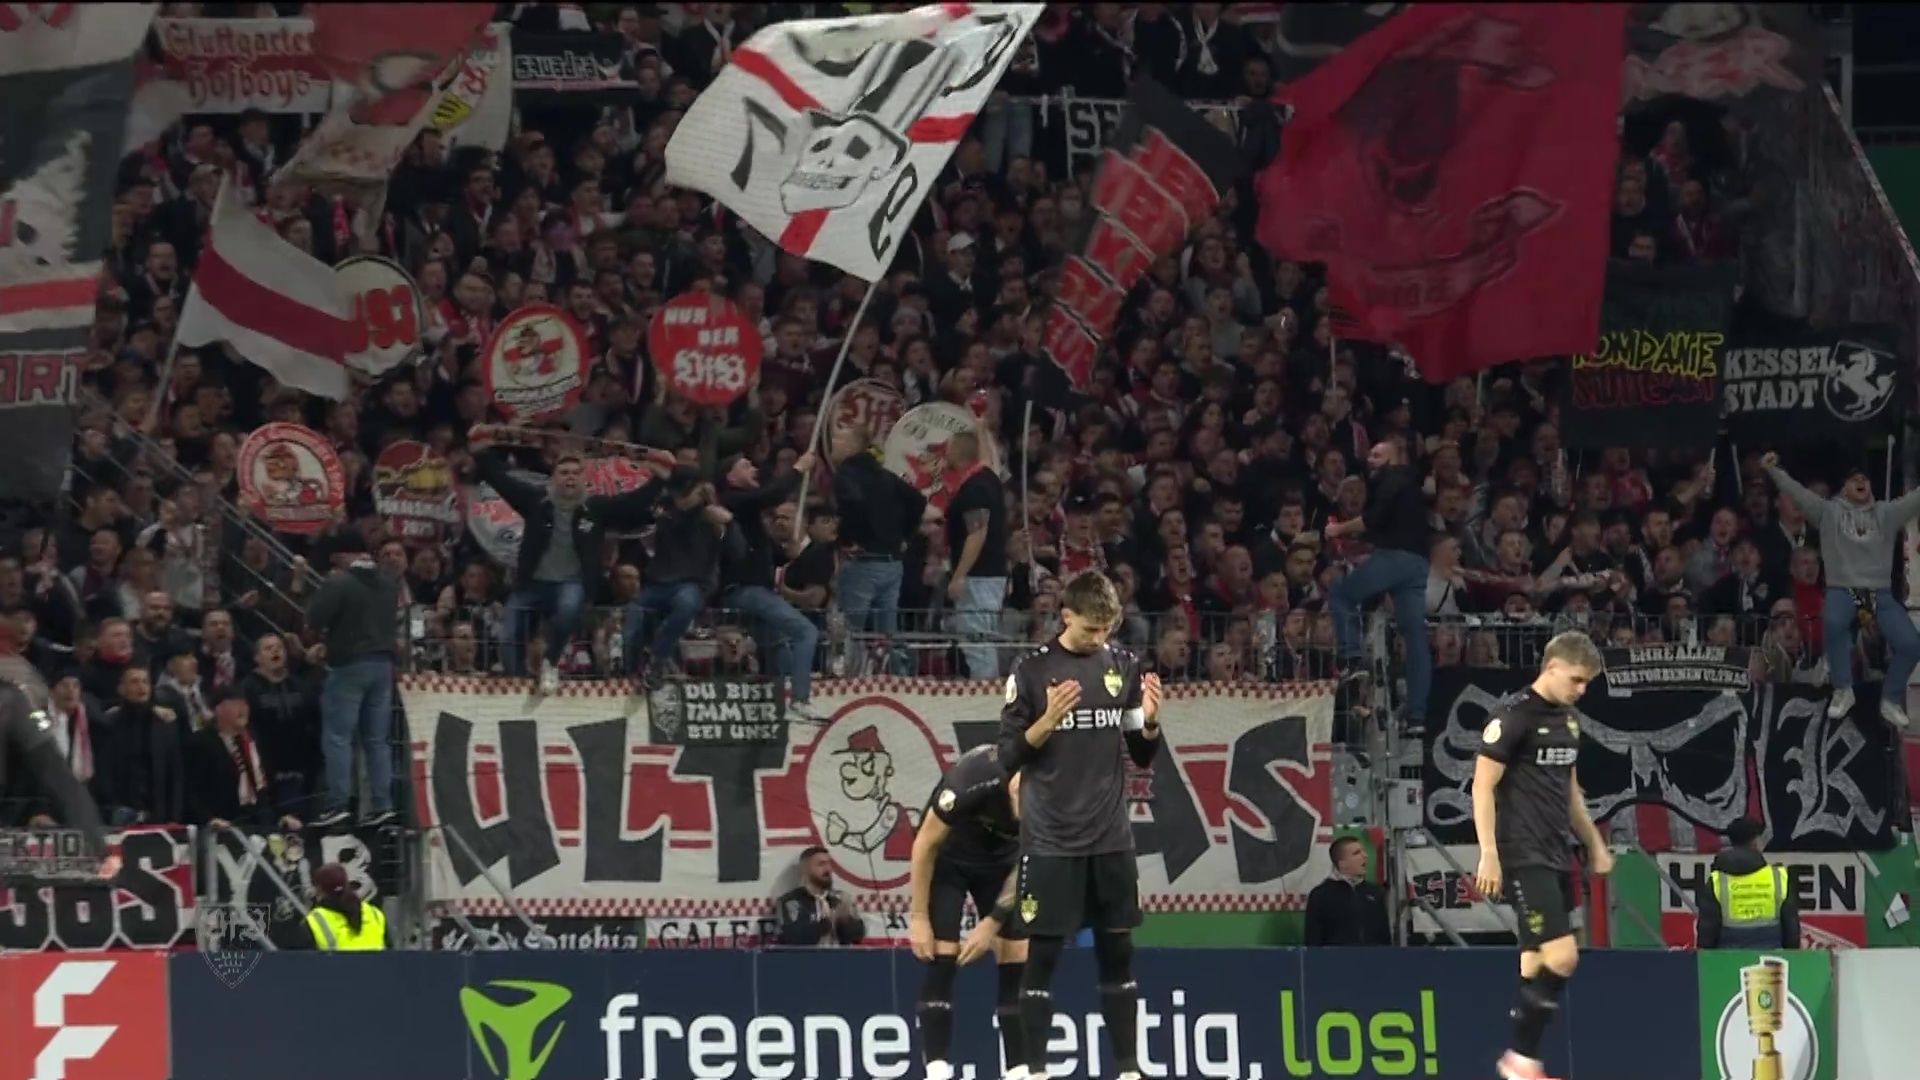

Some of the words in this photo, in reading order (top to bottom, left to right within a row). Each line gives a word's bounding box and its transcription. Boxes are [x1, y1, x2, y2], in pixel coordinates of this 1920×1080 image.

[1724, 347, 1836, 380] KESSEL
[1724, 379, 1819, 412] STADT
[684, 682, 717, 700] DU
[725, 682, 776, 700] BIST
[685, 702, 779, 722] IMMER
[687, 723, 722, 739] BEI
[730, 723, 781, 740] UNS!
[1280, 989, 1440, 1076] los!
